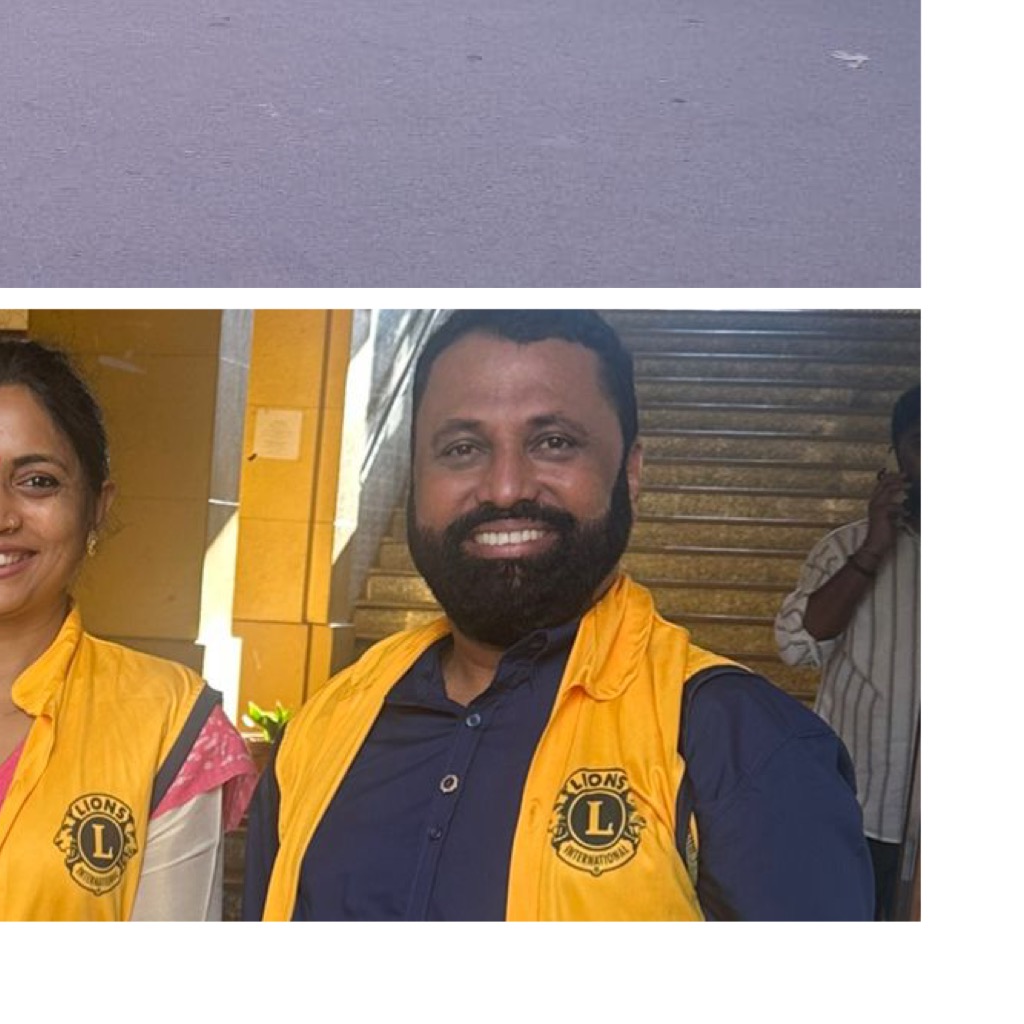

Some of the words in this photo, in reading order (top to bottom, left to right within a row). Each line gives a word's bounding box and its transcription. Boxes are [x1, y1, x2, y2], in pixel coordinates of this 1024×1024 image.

[570, 773, 629, 790] LIONS
[74, 797, 128, 819] LIONS
[584, 800, 615, 836] L
[91, 823, 114, 859] L
[563, 844, 630, 866] INTERNATIONAL
